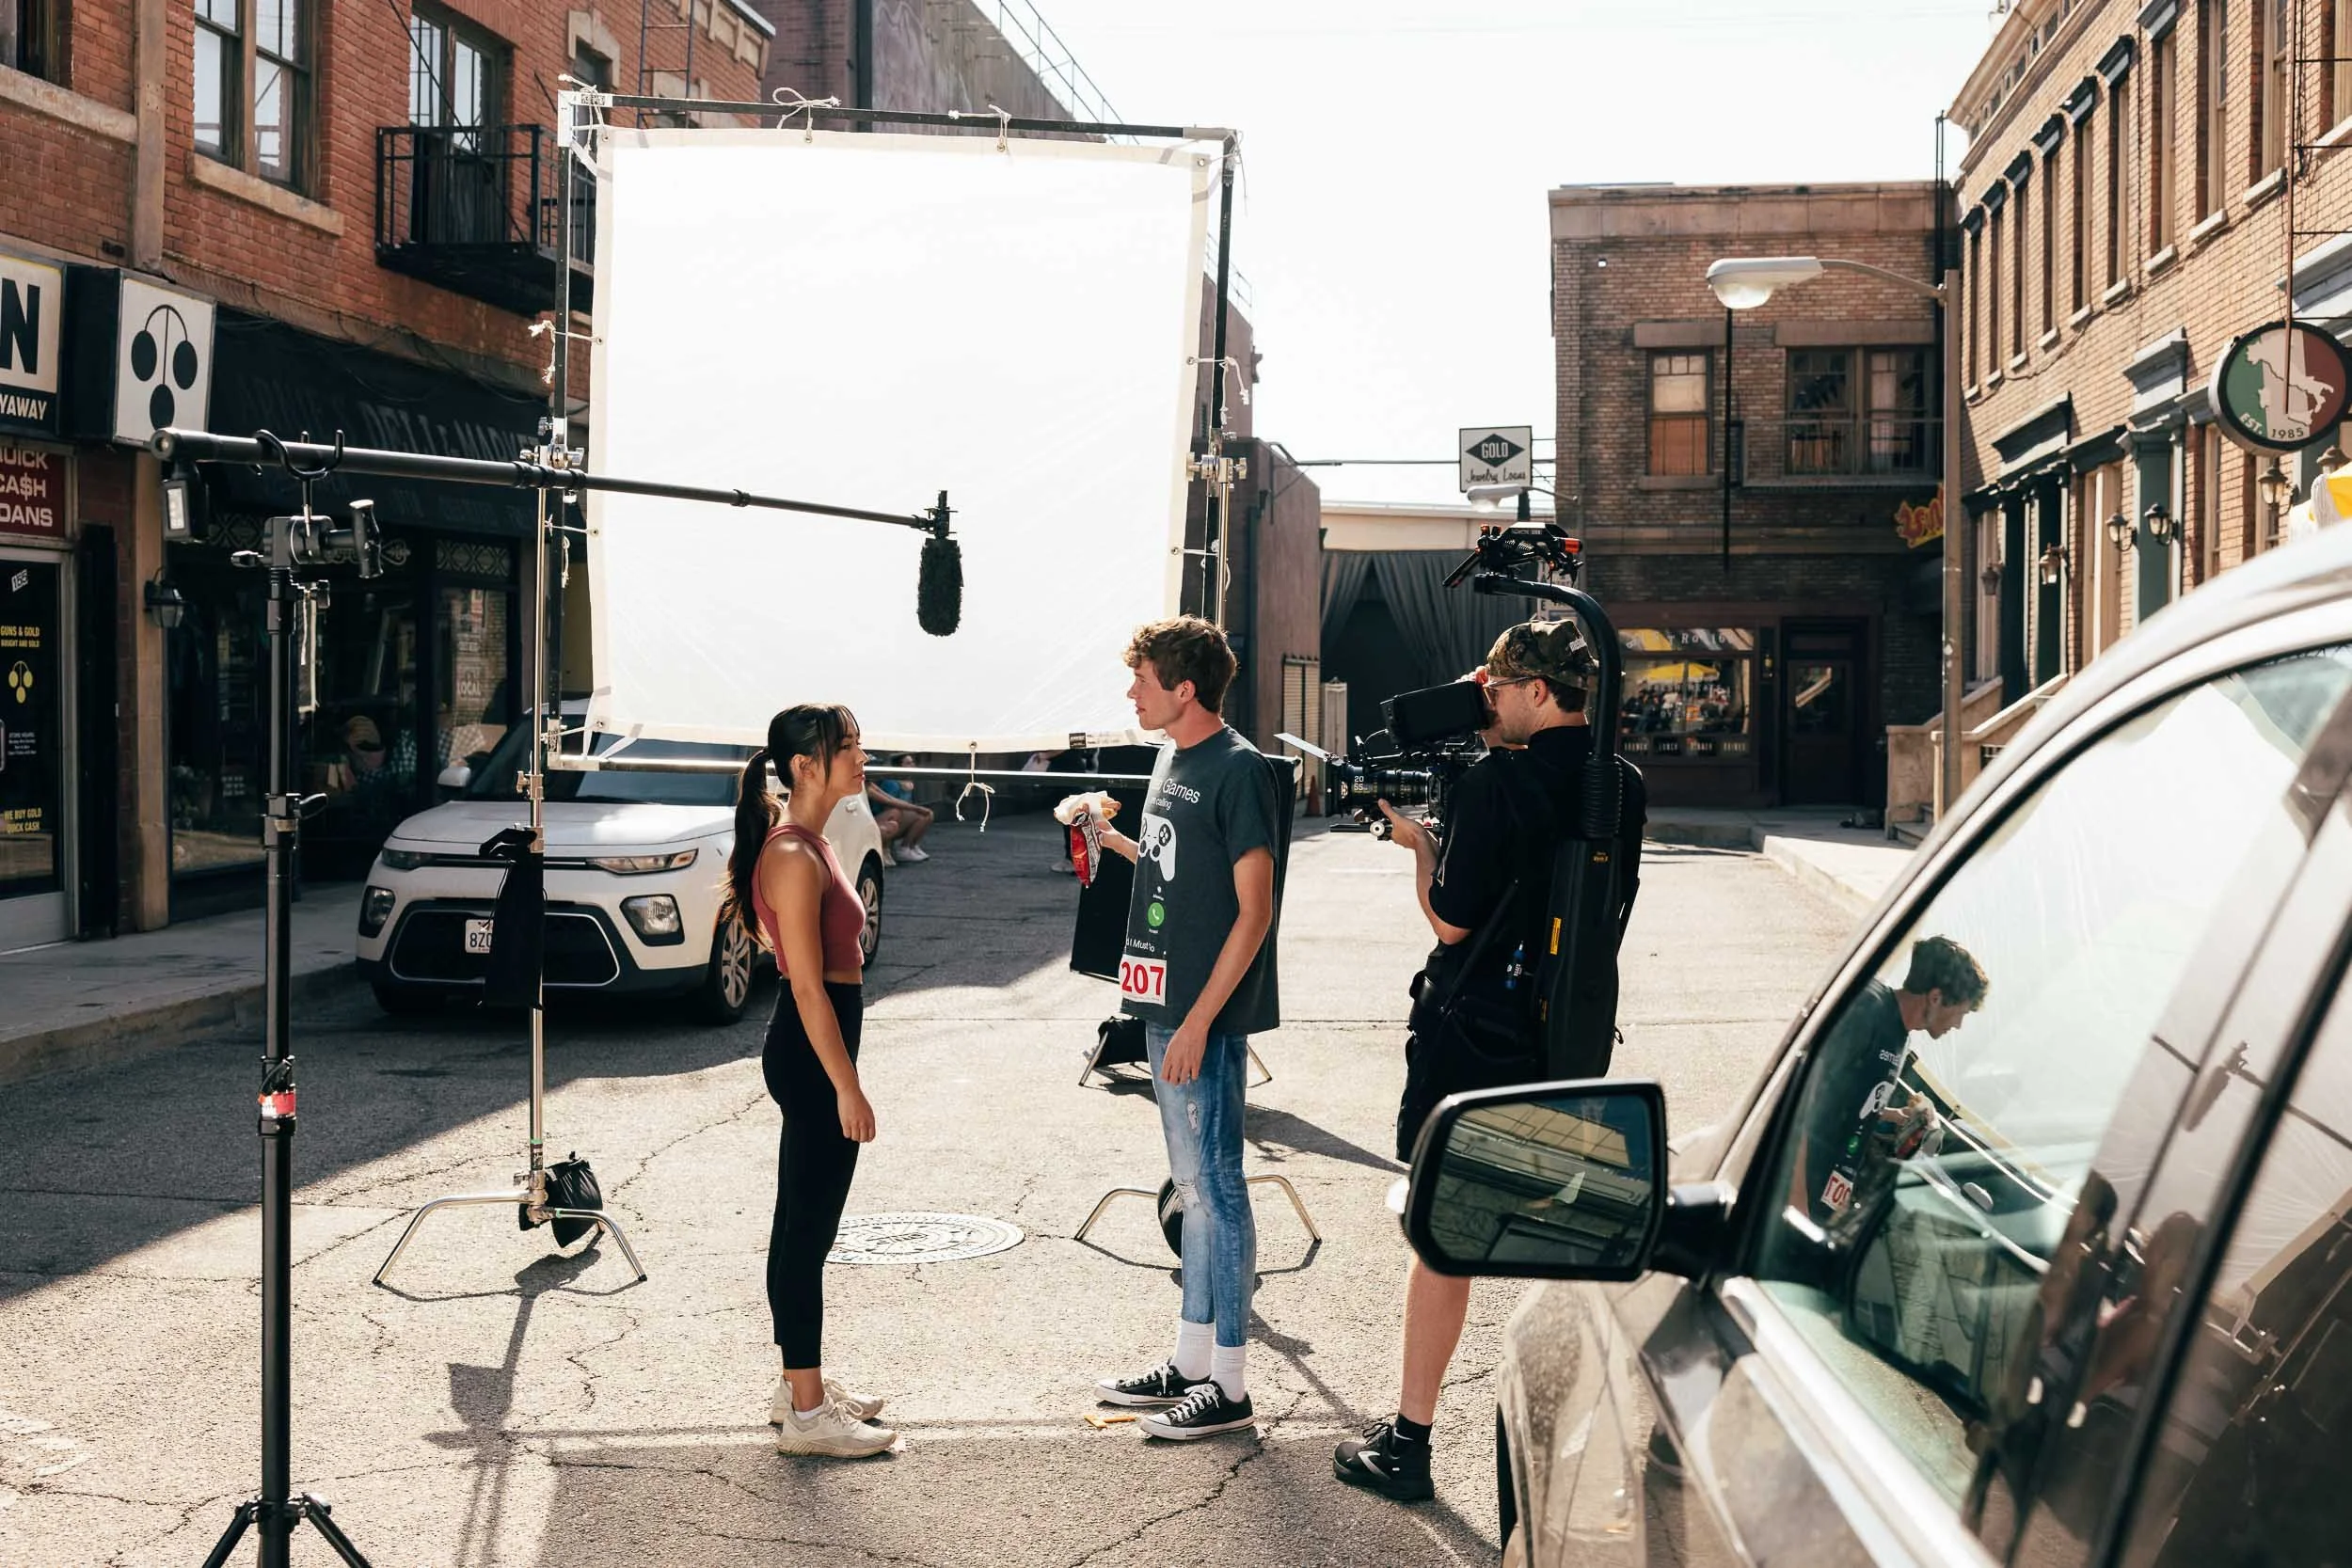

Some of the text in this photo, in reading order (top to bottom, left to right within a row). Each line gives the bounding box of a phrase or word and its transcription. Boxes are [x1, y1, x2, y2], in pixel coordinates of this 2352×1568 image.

[0, 393, 47, 420] YAWAY
[2238, 412, 2304, 439] EST. 1985
[0, 447, 49, 470] UICK
[1481, 442, 1509, 459] GOLD
[0, 625, 17, 638] GUNS
[24, 626, 40, 638] GOLD
[1162, 777, 1201, 804] Games
[1121, 961, 1165, 996] 207
